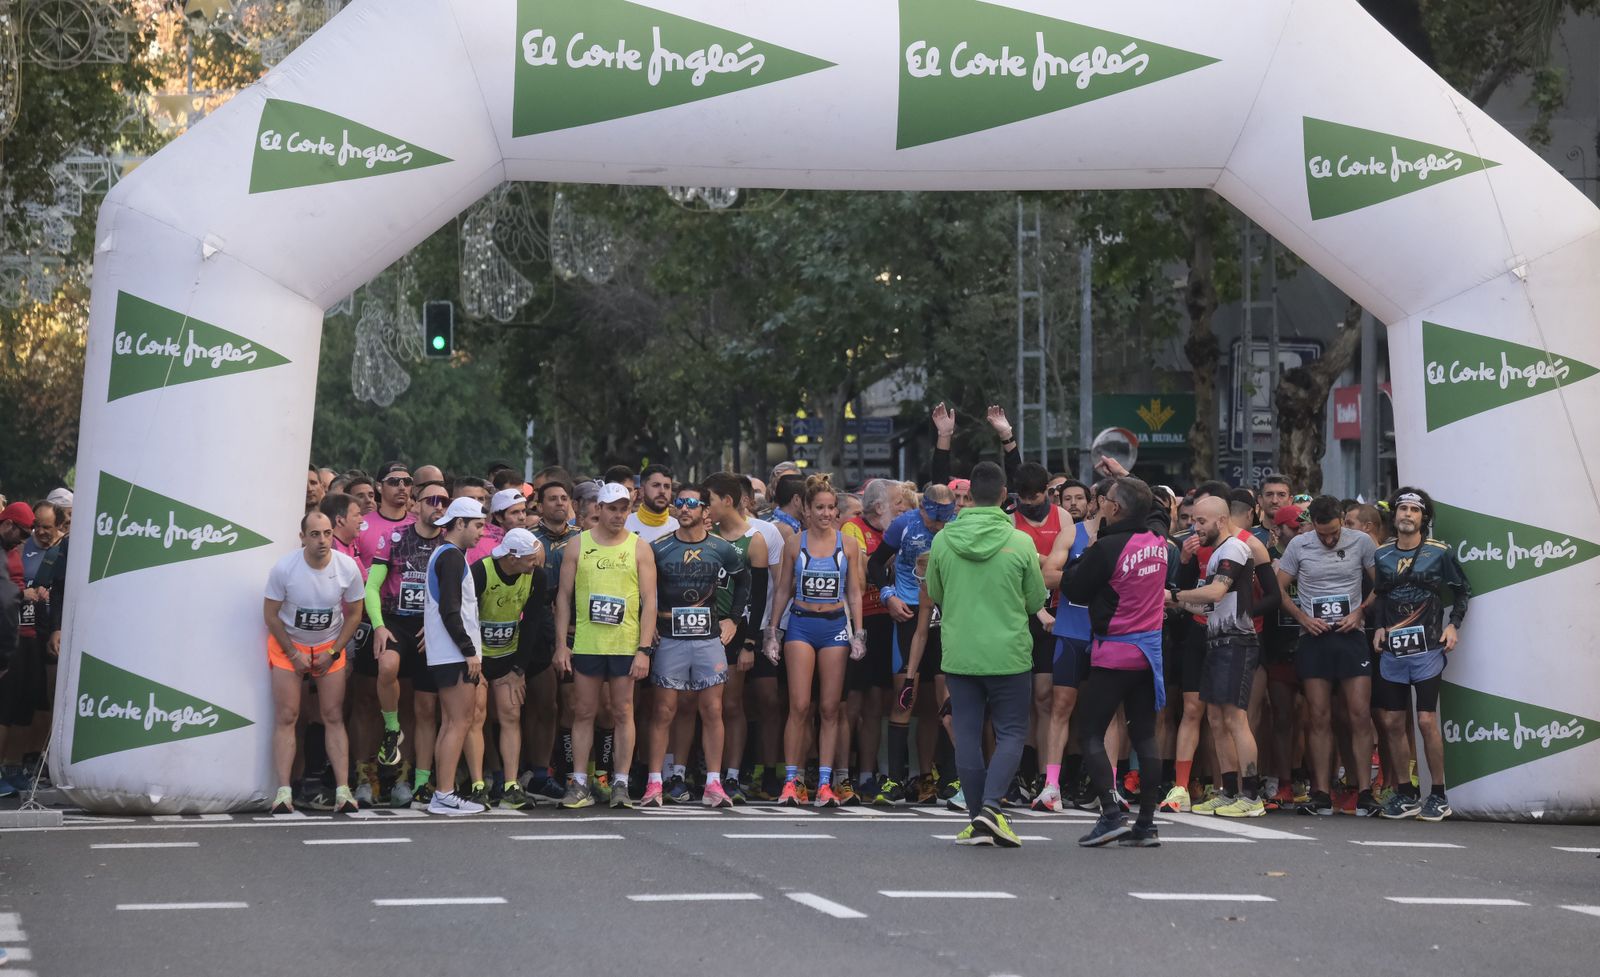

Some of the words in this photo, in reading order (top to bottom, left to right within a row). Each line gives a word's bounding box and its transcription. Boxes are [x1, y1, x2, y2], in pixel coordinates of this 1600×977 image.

[522, 28, 558, 65] El
[566, 32, 642, 71] Corte
[648, 26, 766, 86] Inglés
[906, 40, 941, 78] El
[950, 42, 1026, 78] Corte
[1032, 31, 1150, 91] Inglés
[259, 130, 282, 150] El
[287, 132, 335, 157] Corte
[337, 128, 412, 169] Inglés
[1308, 155, 1332, 178] El
[1337, 155, 1386, 176] Corte
[1390, 147, 1462, 182] Inglés
[115, 331, 132, 355] El
[136, 333, 181, 357] Corte
[183, 330, 257, 369] Inglés
[1426, 361, 1446, 385] El
[1449, 361, 1496, 384] Corte
[1500, 351, 1569, 389] Inglés
[1151, 432, 1186, 443] RURAL
[96, 511, 113, 536] El
[116, 513, 161, 539] Corte
[164, 511, 239, 550] Inglés
[1457, 540, 1503, 563] Corte
[1506, 533, 1577, 569] Inglés
[404, 589, 425, 602] 34
[805, 577, 836, 591] 402
[22, 604, 36, 616] 29
[300, 612, 330, 624] 156
[591, 600, 622, 616] 547
[677, 614, 707, 627] 105
[1321, 601, 1342, 615] 36
[484, 627, 514, 639] 548
[1392, 632, 1420, 649] 571
[79, 693, 94, 717] El
[98, 695, 142, 720] Corte
[143, 692, 219, 733] Inglés
[1443, 719, 1462, 744] El
[1465, 719, 1510, 743] Corte
[1513, 712, 1585, 750] Inglés
[563, 734, 574, 763] WONG
[602, 734, 613, 764] WONG
